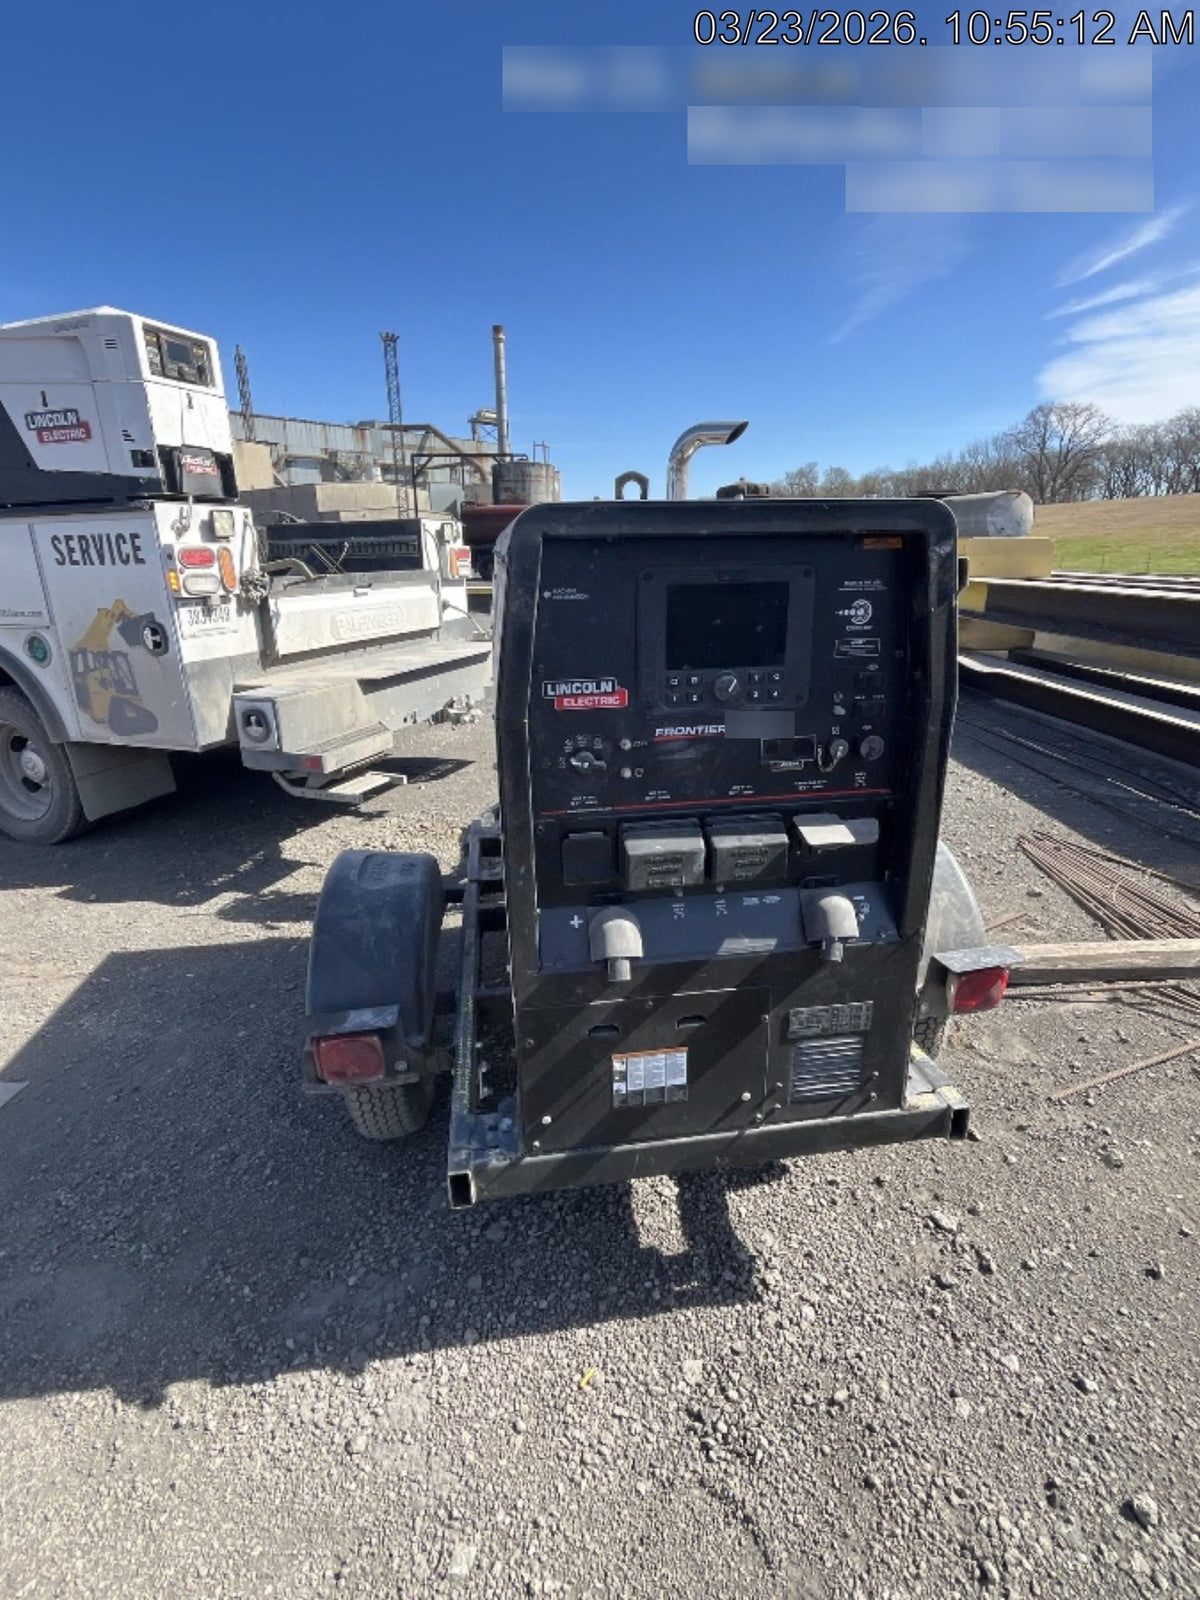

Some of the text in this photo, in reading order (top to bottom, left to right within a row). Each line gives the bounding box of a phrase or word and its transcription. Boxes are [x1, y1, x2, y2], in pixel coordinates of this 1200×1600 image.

[27, 411, 78, 429] LINCOLN
[42, 427, 86, 442] ELECTRIC
[50, 532, 147, 566] SERVICE
[547, 680, 613, 696] LINCOLN
[562, 695, 621, 707] ELECTRIC
[655, 724, 726, 737] FRONTIER
